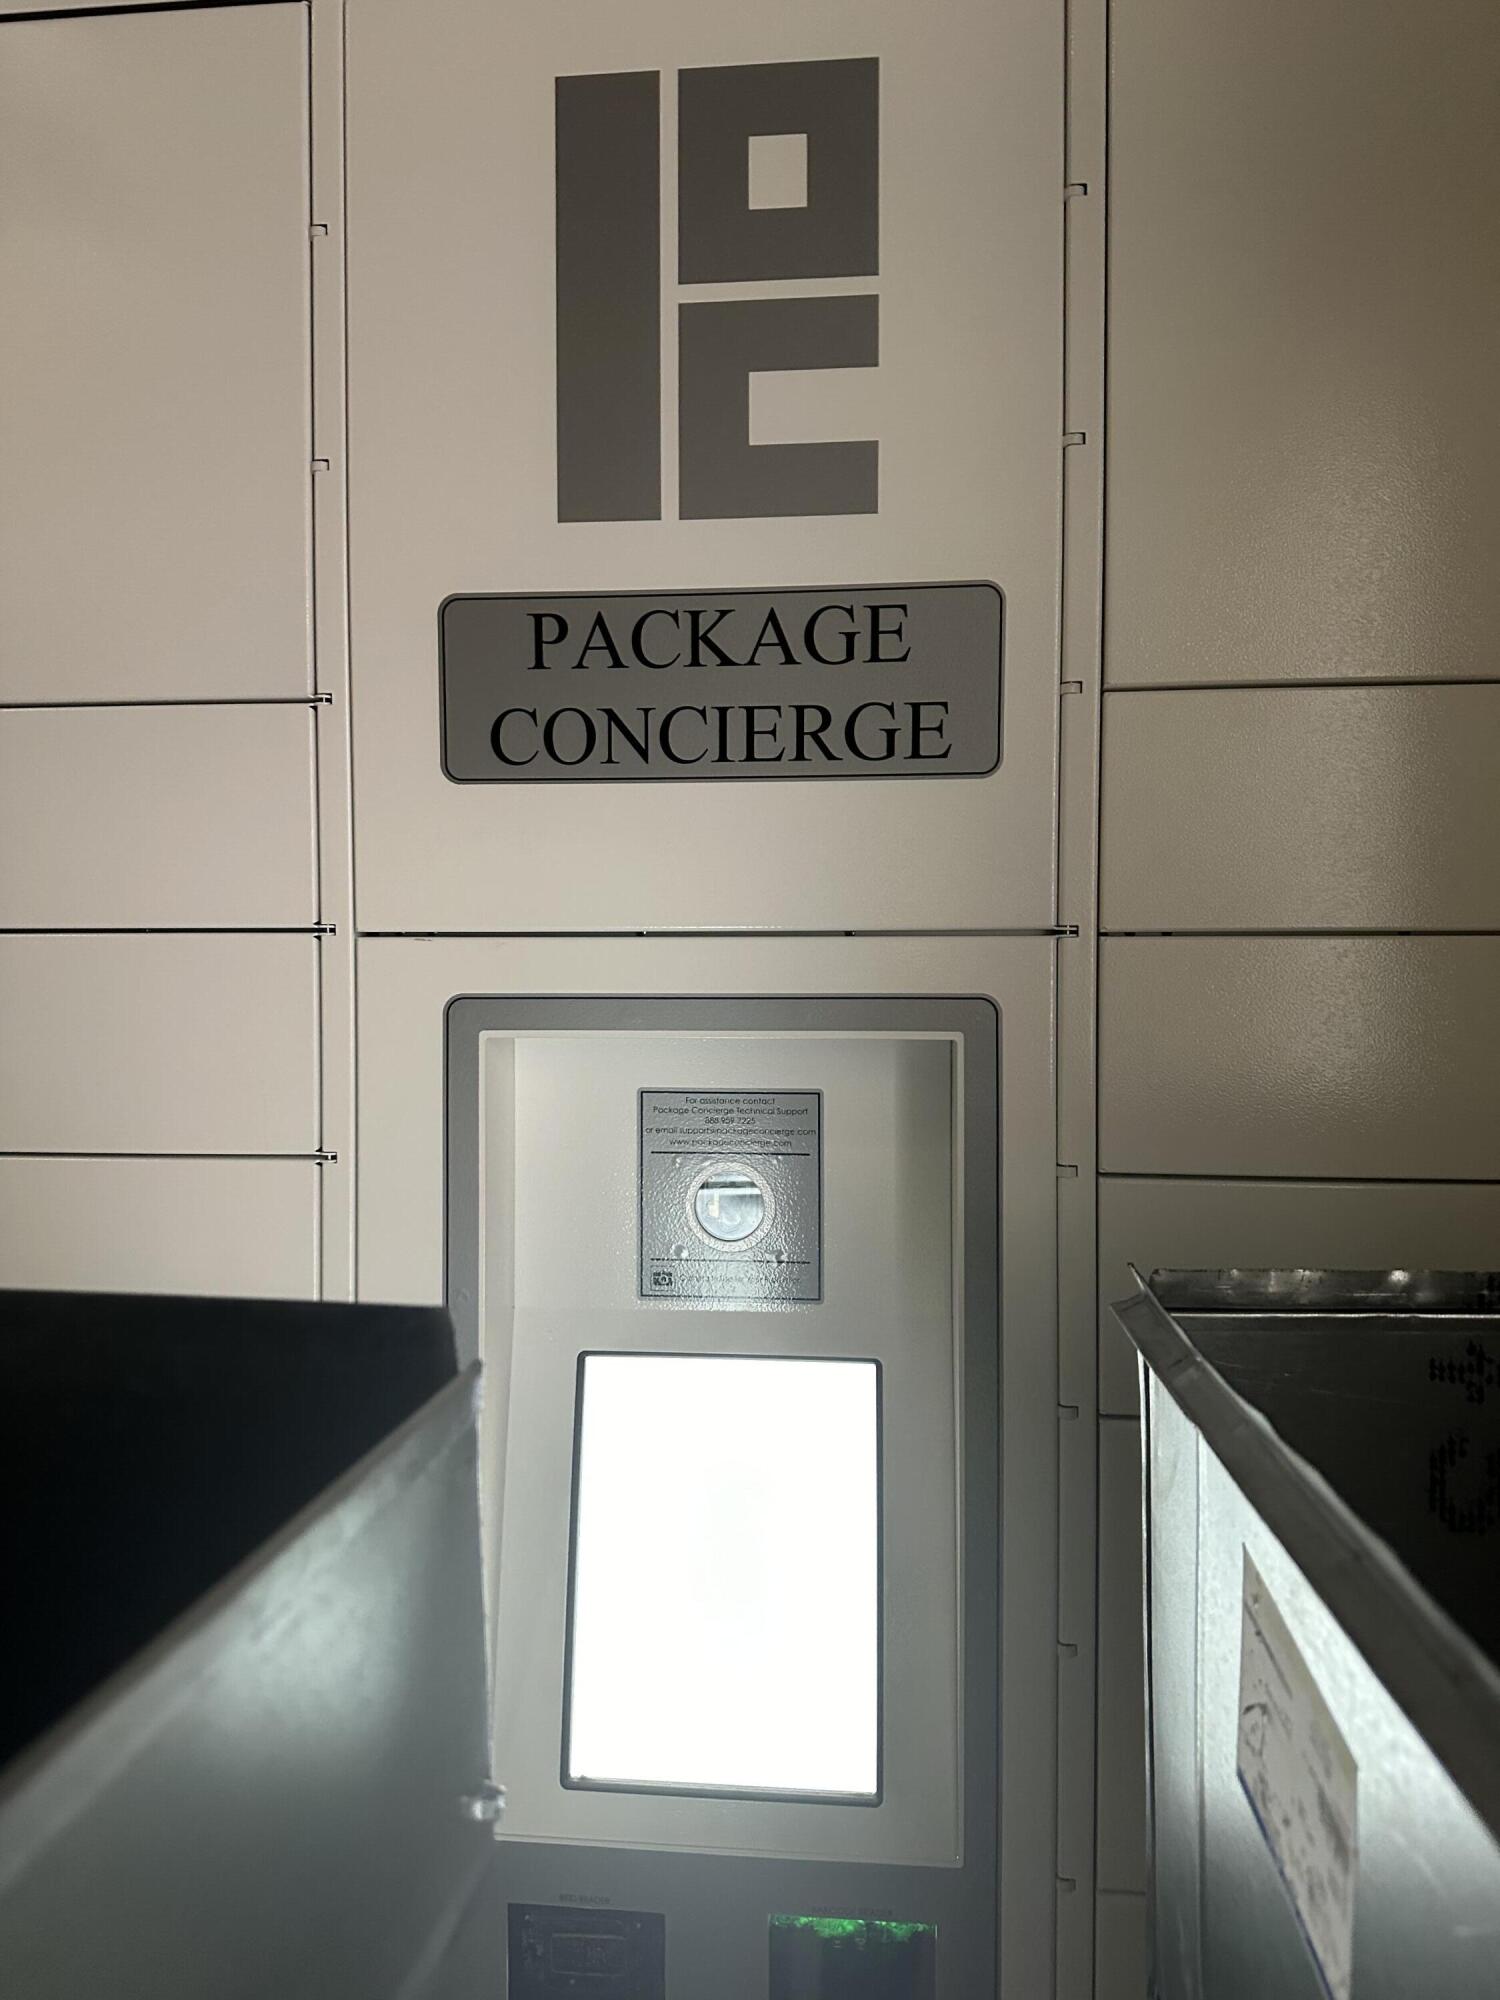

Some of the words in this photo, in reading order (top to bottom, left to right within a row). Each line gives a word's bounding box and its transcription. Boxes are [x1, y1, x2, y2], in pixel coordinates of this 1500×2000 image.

[525, 602, 912, 670] PACKAGE
[490, 700, 953, 766] CONCIERGE
[685, 1096, 698, 1104] For
[699, 1096, 740, 1105] assistance
[742, 1097, 775, 1105] contact
[653, 1105, 690, 1115] Package
[691, 1105, 735, 1115] Concierge
[736, 1106, 775, 1115] Technical
[776, 1107, 808, 1116] Support
[655, 1126, 678, 1134] email
